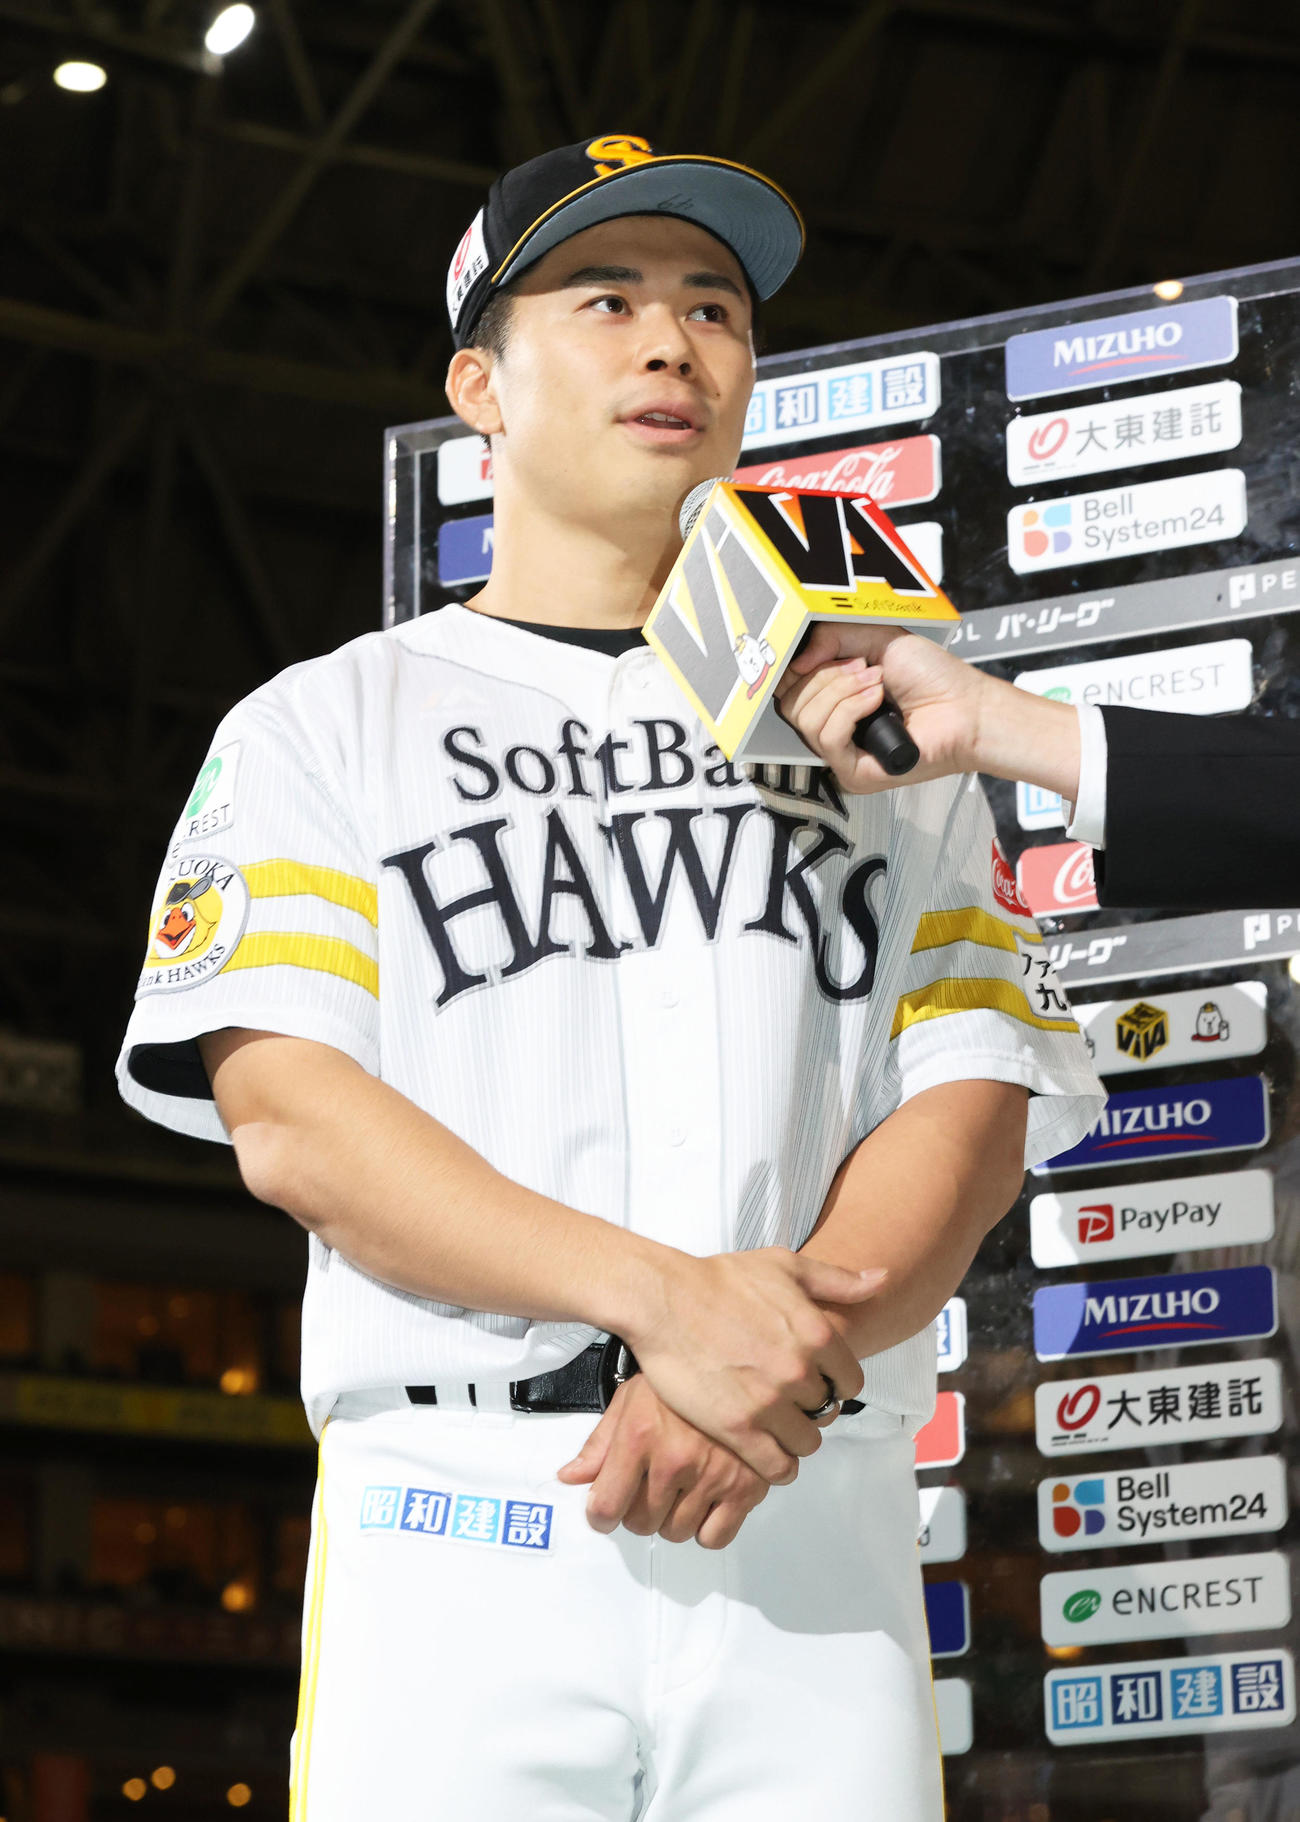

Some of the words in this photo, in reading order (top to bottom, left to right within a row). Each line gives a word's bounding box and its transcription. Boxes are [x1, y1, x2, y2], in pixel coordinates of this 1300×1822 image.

[1053, 322, 1183, 368] MIZUHO
[1075, 400, 1222, 456] 大東建託
[1084, 493, 1133, 522] Bell
[1084, 504, 1225, 551] System24
[379, 803, 888, 1008] HAWKS
[1022, 953, 1057, 978] ファ
[1120, 1201, 1222, 1233] PayPay
[1084, 1287, 1220, 1327] MIZUHO
[1107, 1377, 1262, 1430] 大東建託
[1117, 1472, 1170, 1502] Bell
[361, 1488, 551, 1548] 昭和建設
[1117, 1493, 1268, 1537] System24
[1112, 1576, 1264, 1616] eNCREST
[1055, 1664, 1281, 1727] 昭和建設
